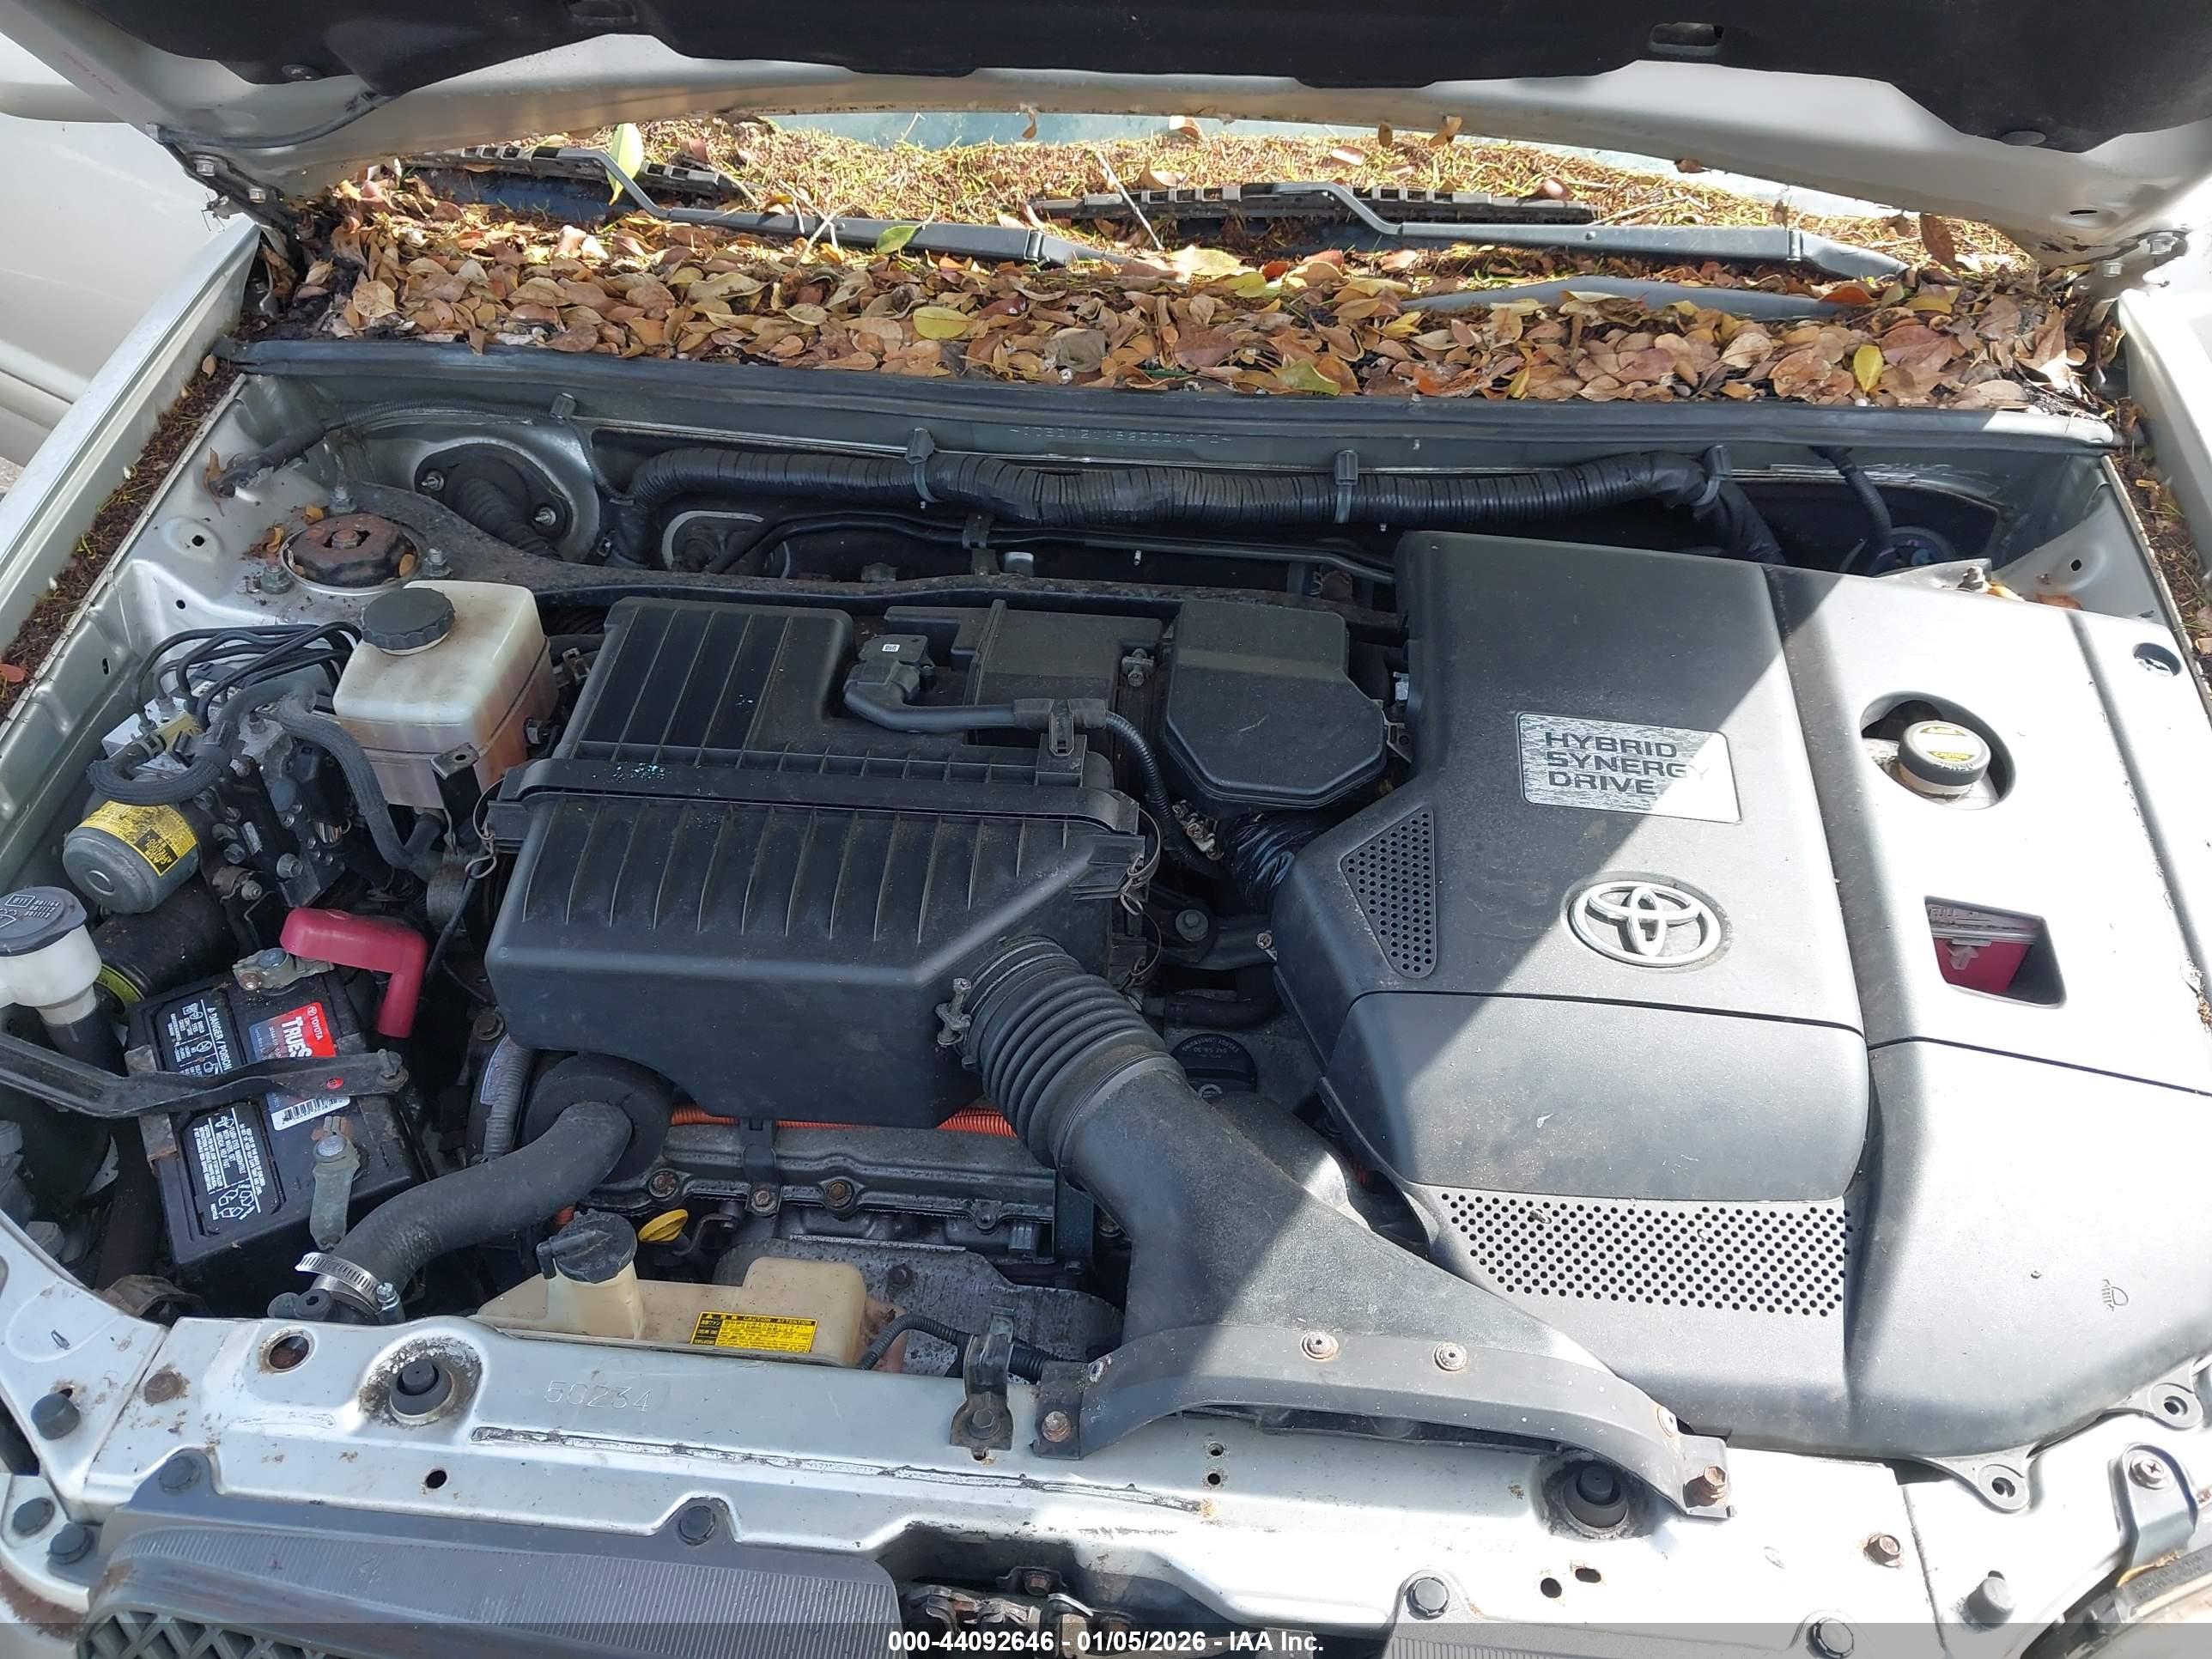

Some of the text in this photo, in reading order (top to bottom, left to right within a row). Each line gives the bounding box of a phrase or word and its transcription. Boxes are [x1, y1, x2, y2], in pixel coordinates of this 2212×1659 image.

[1546, 732, 1677, 758] HYBRID
[1546, 750, 1710, 780] SYNERGY
[1548, 770, 1656, 795] DRIVE
[310, 1016, 324, 1040] TOYOTA
[209, 1013, 224, 1040] DANGER
[218, 1044, 233, 1071] POISON
[776, 1317, 812, 1326] ATTENTION
[543, 1379, 652, 1413] 50234
